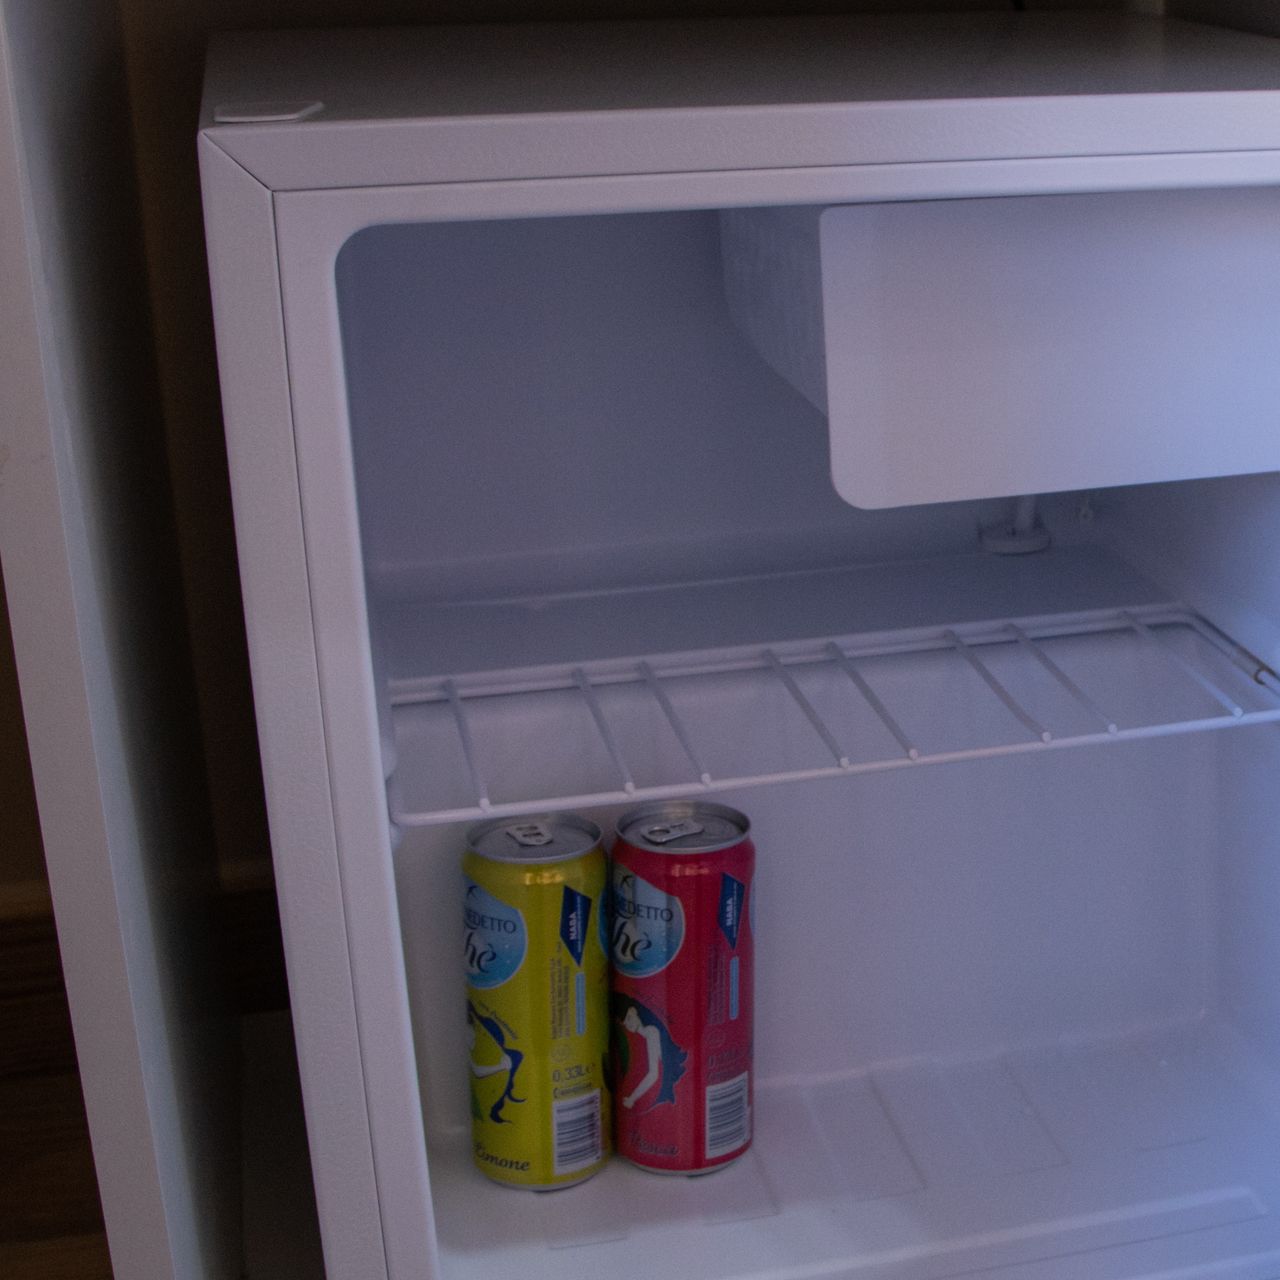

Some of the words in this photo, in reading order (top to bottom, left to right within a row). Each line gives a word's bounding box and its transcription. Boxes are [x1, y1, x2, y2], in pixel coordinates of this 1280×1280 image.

[465, 909, 517, 934] EDETTO
[613, 900, 674, 923] EDETTO
[464, 931, 498, 974] hè
[612, 920, 652, 962] hè
